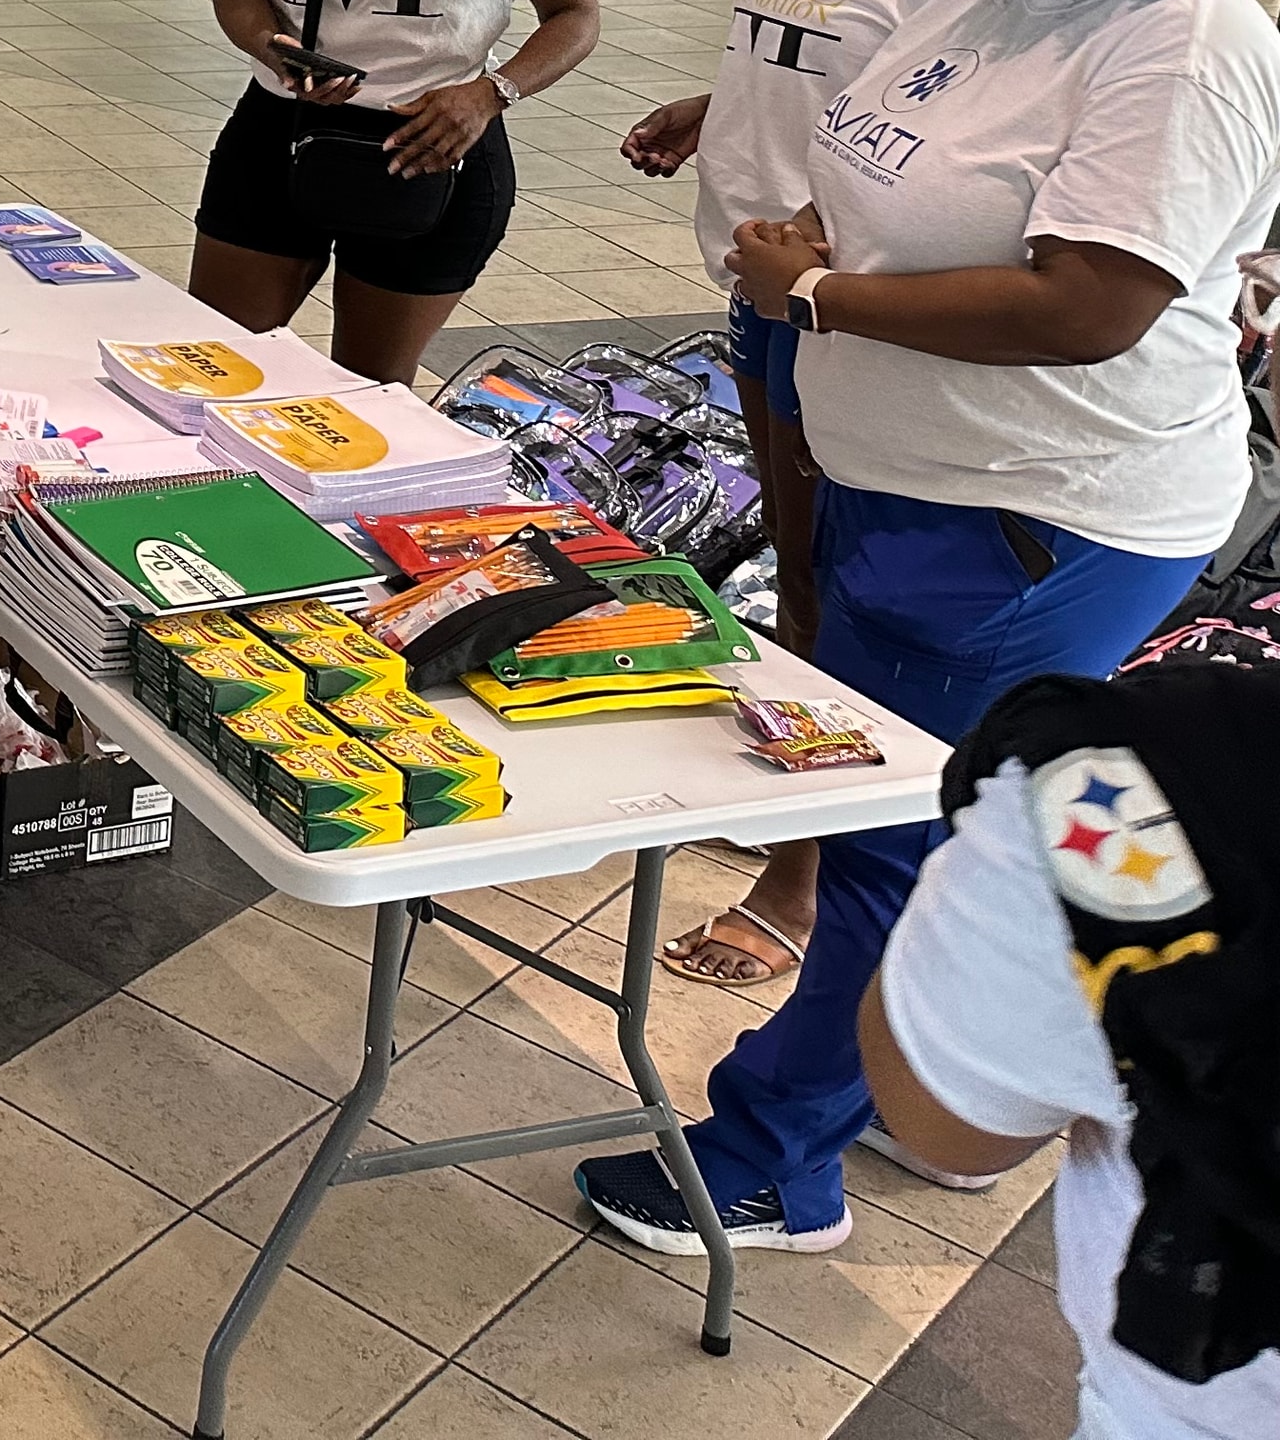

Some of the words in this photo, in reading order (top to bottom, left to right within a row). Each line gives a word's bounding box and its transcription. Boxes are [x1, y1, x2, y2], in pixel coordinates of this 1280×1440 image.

[169, 345, 229, 378] PAPER
[302, 403, 330, 421] FILLER
[281, 405, 351, 445] PAPER
[141, 549, 175, 571] 70
[61, 799, 76, 811] Lot
[78, 798, 86, 808] #
[89, 805, 108, 816] QTY
[11, 817, 57, 835] 4510788
